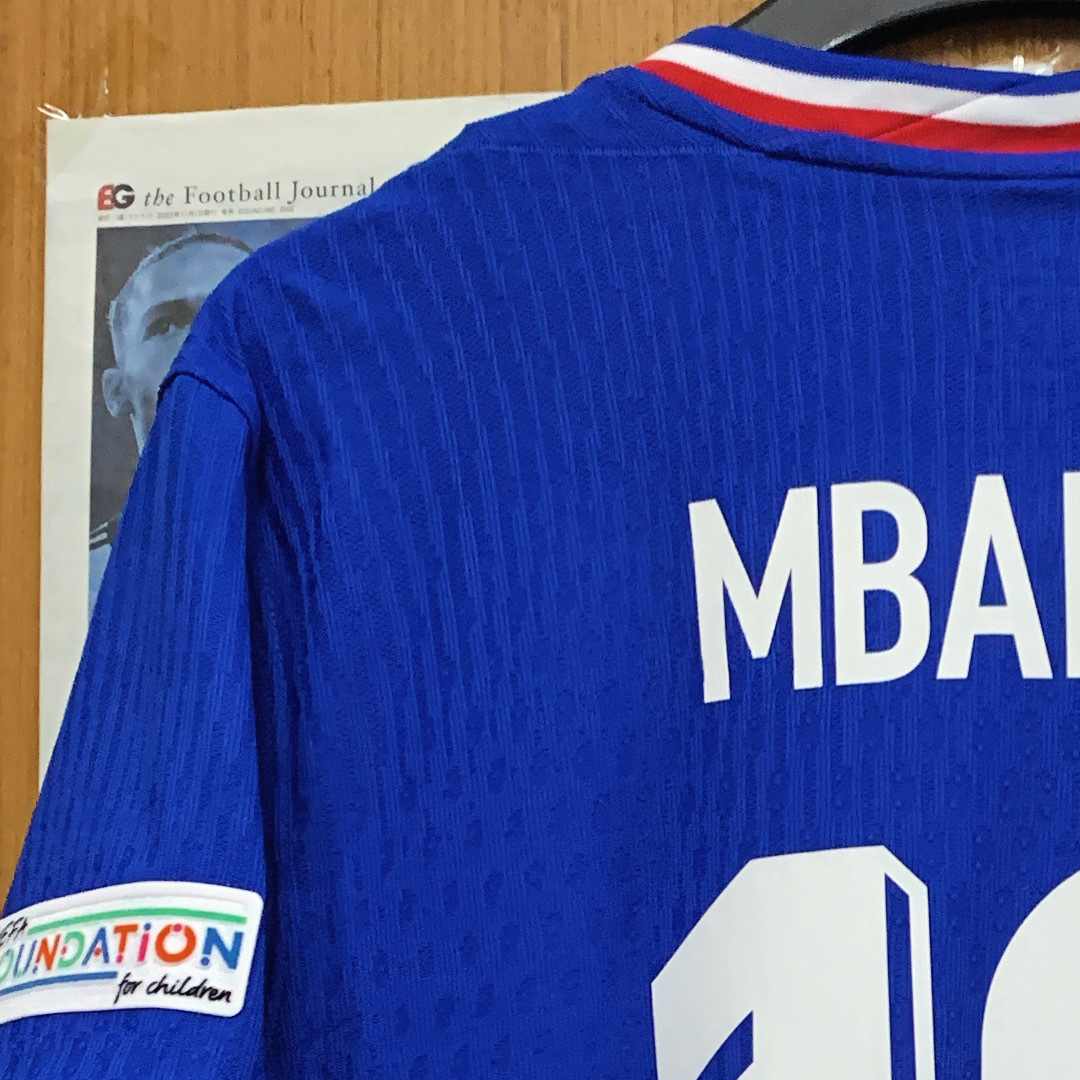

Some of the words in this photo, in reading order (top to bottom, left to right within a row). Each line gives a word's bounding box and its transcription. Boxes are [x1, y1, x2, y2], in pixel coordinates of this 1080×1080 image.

[144, 188, 174, 207] the
[184, 181, 280, 205] Football
[286, 177, 374, 205] Journal
[114, 972, 139, 1004] for
[146, 975, 231, 1003] children
